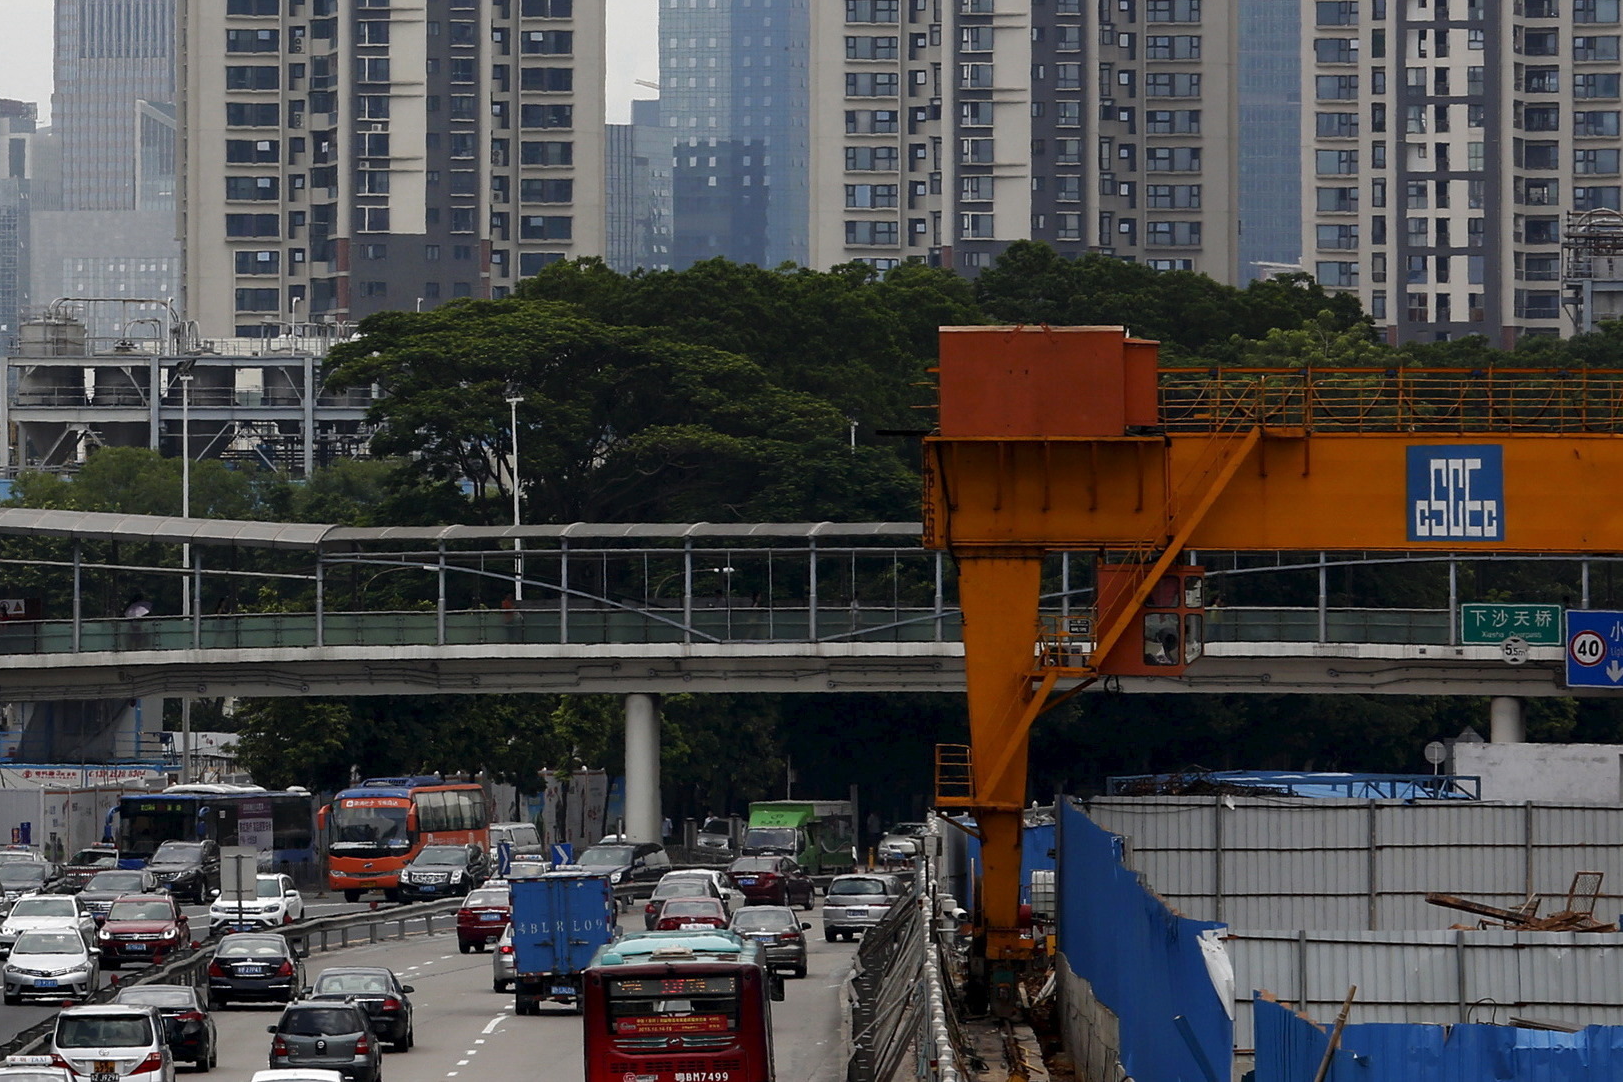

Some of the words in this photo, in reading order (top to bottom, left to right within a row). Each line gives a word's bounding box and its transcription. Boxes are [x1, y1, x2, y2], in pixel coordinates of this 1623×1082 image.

[1416, 458, 1497, 537] CSCEC
[1470, 609, 1552, 628] 下沙天桥
[1481, 630, 1505, 638] Xiasha
[1577, 639, 1600, 657] 40
[675, 1072, 729, 1082] 粤BM7499
